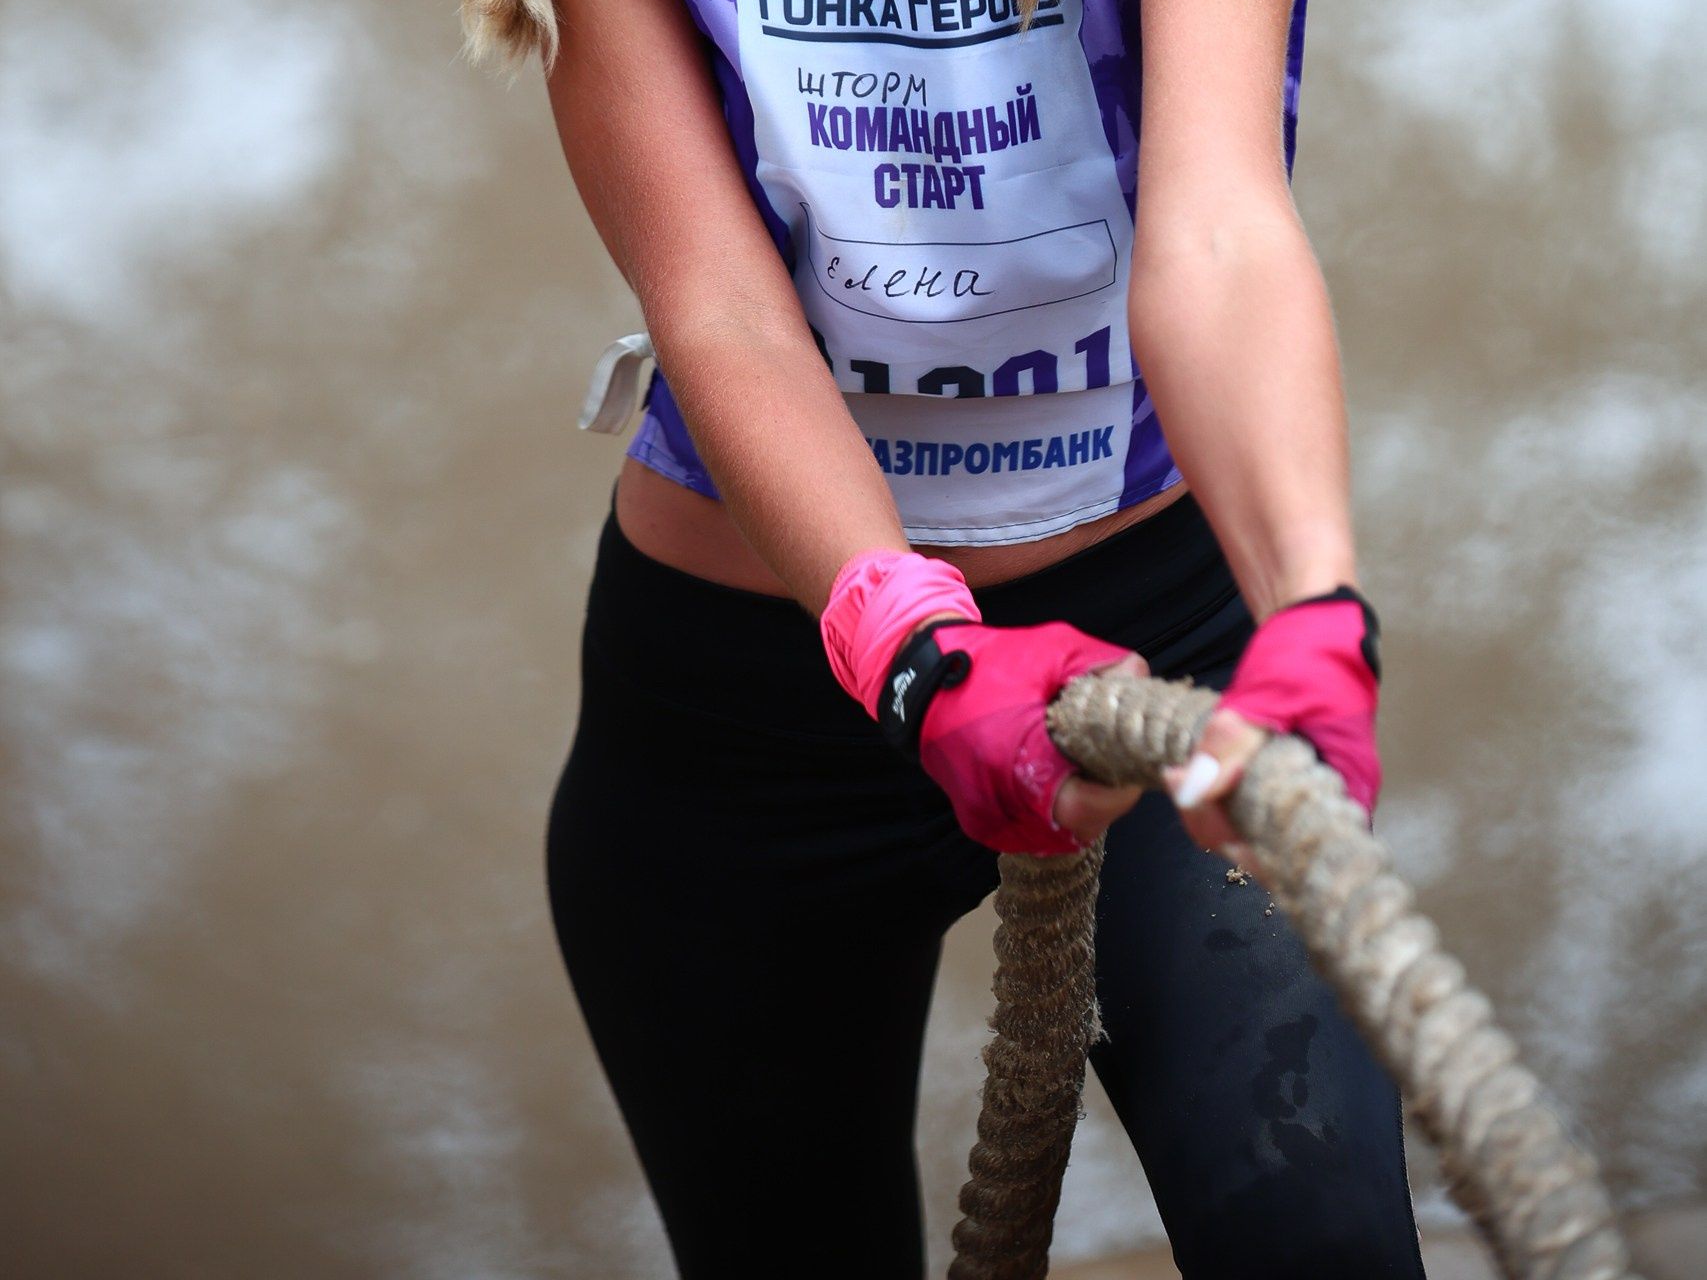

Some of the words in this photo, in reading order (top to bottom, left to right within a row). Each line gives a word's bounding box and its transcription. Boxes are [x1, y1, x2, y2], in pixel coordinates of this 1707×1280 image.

[798, 67, 928, 107] ШТОРМ
[807, 83, 1042, 164] КОМАНДНЫЙ
[873, 163, 986, 210] СТАРТ
[827, 257, 998, 297] Елена
[866, 425, 1114, 477] АЗПРОМБАНК
